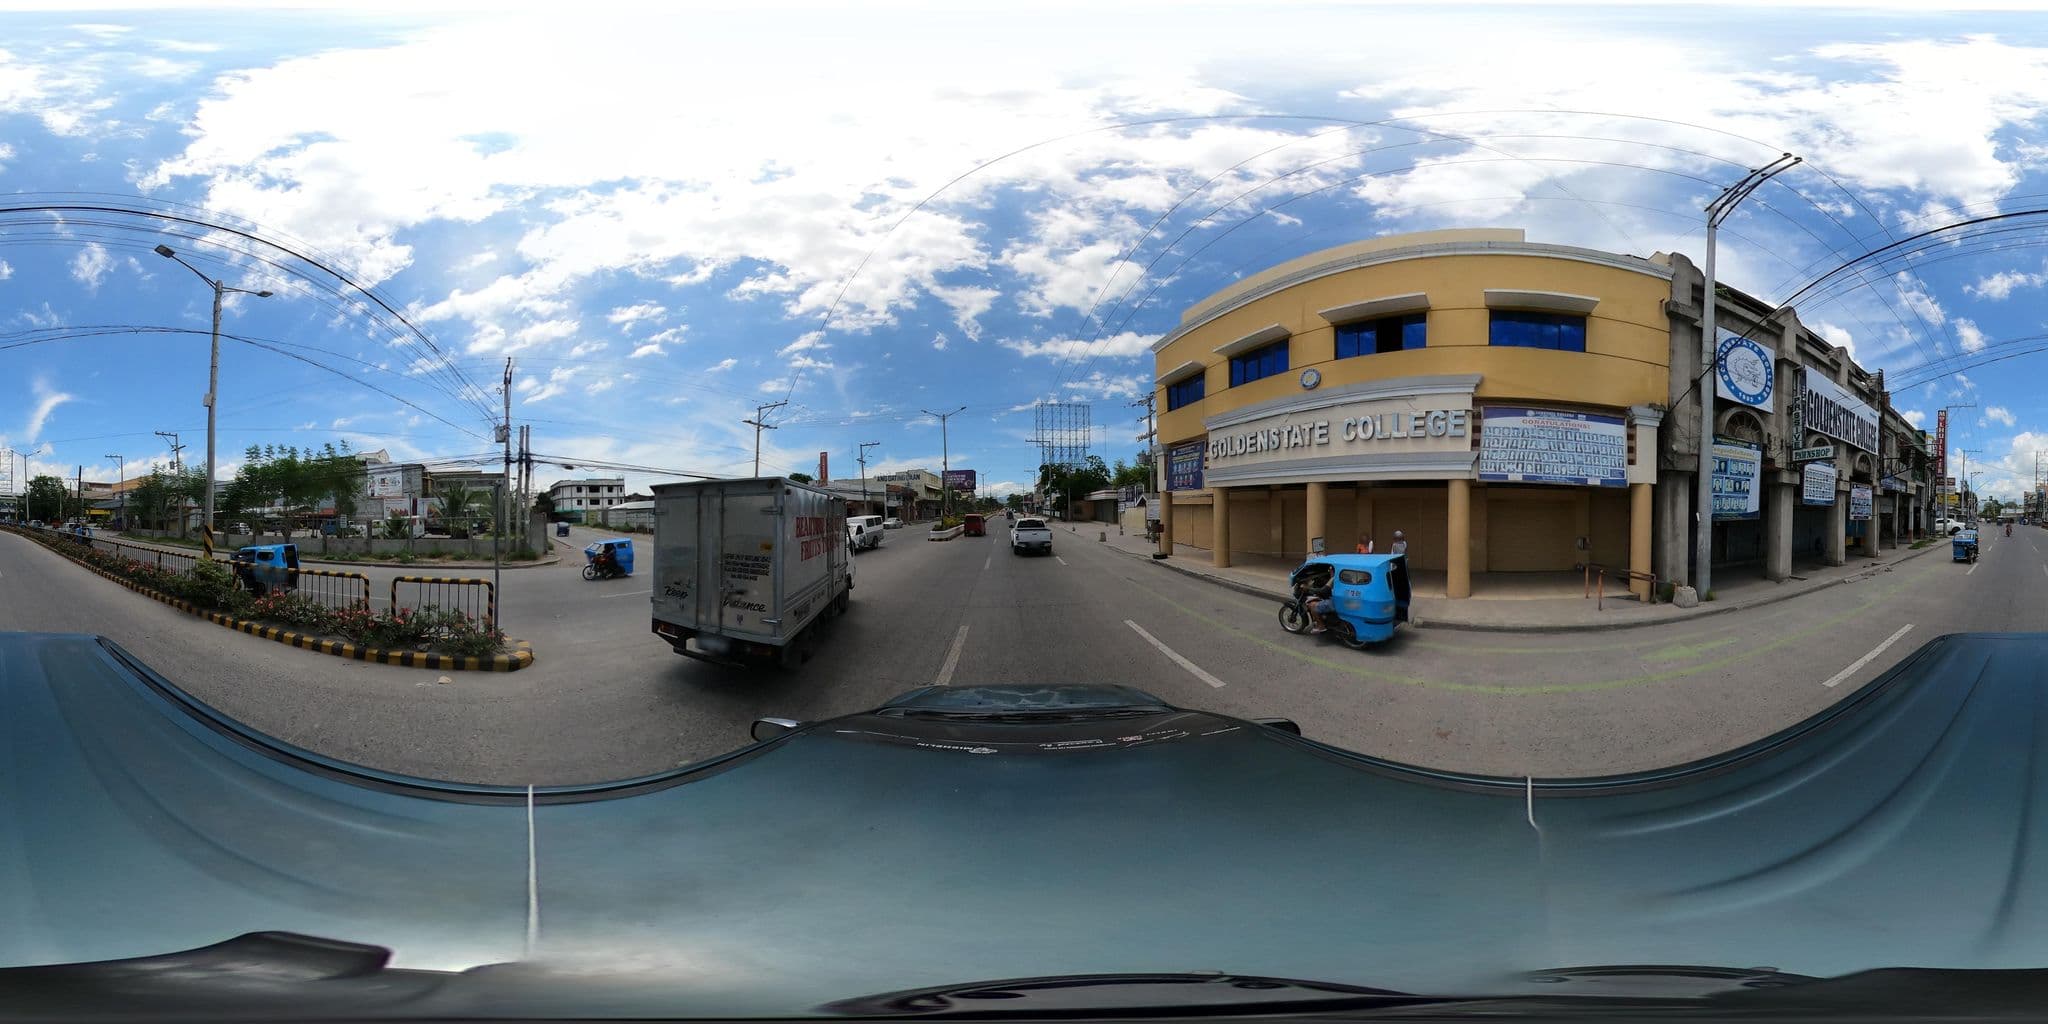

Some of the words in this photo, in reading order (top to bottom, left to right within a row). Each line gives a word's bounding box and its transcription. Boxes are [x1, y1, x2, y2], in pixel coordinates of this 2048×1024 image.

[1210, 420, 1329, 459] GOLDENSTATE
[1342, 410, 1466, 442] COLLEGE
[1807, 389, 1856, 444] GOLDENSTATE
[1856, 416, 1877, 453] COLLEGE
[1794, 447, 1831, 460] PAWNSHOP
